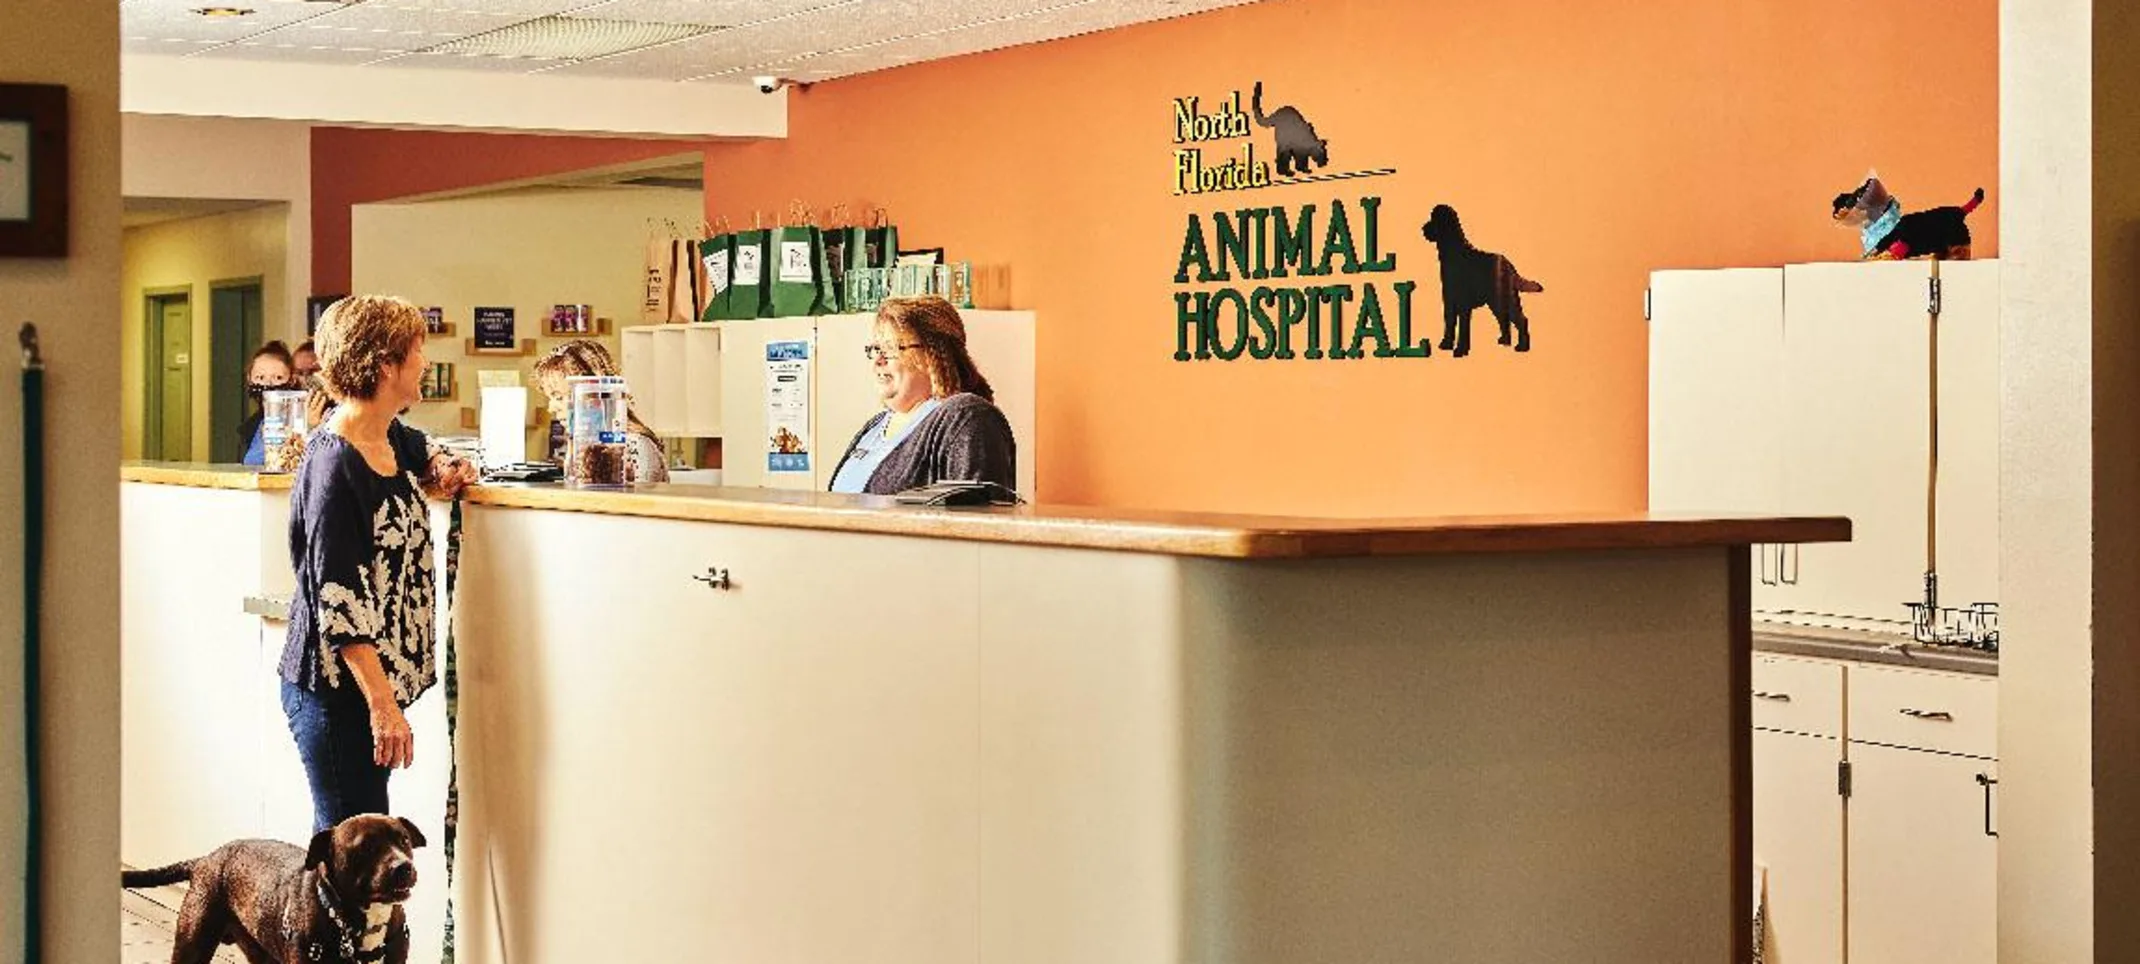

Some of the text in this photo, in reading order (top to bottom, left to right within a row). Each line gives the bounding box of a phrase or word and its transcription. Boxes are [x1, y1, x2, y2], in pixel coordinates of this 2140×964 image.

[1172, 91, 1250, 143] North
[1172, 143, 1271, 195] Florida
[1174, 197, 1396, 283] ANIMAL
[1174, 281, 1431, 360] HOSPITAL
